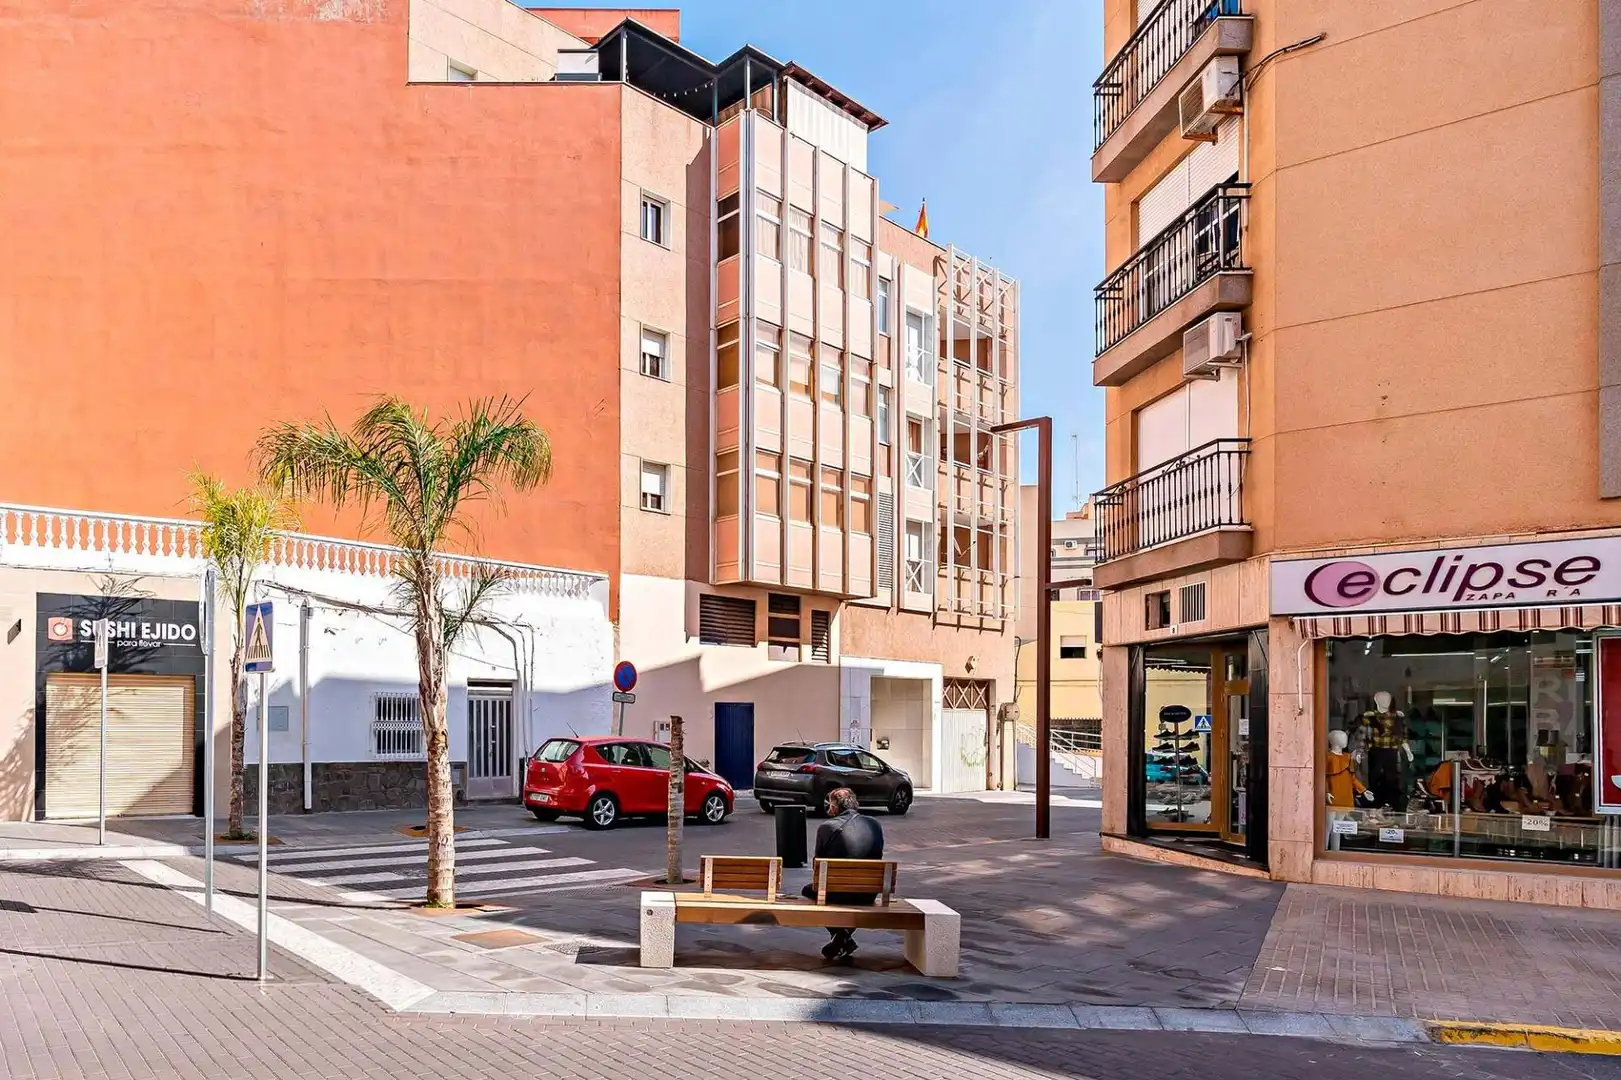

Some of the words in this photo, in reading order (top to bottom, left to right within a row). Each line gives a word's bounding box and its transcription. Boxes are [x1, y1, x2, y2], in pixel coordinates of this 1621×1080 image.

[1337, 555, 1602, 602] eclipse
[141, 622, 197, 640] EJIDO
[117, 640, 137, 648] para
